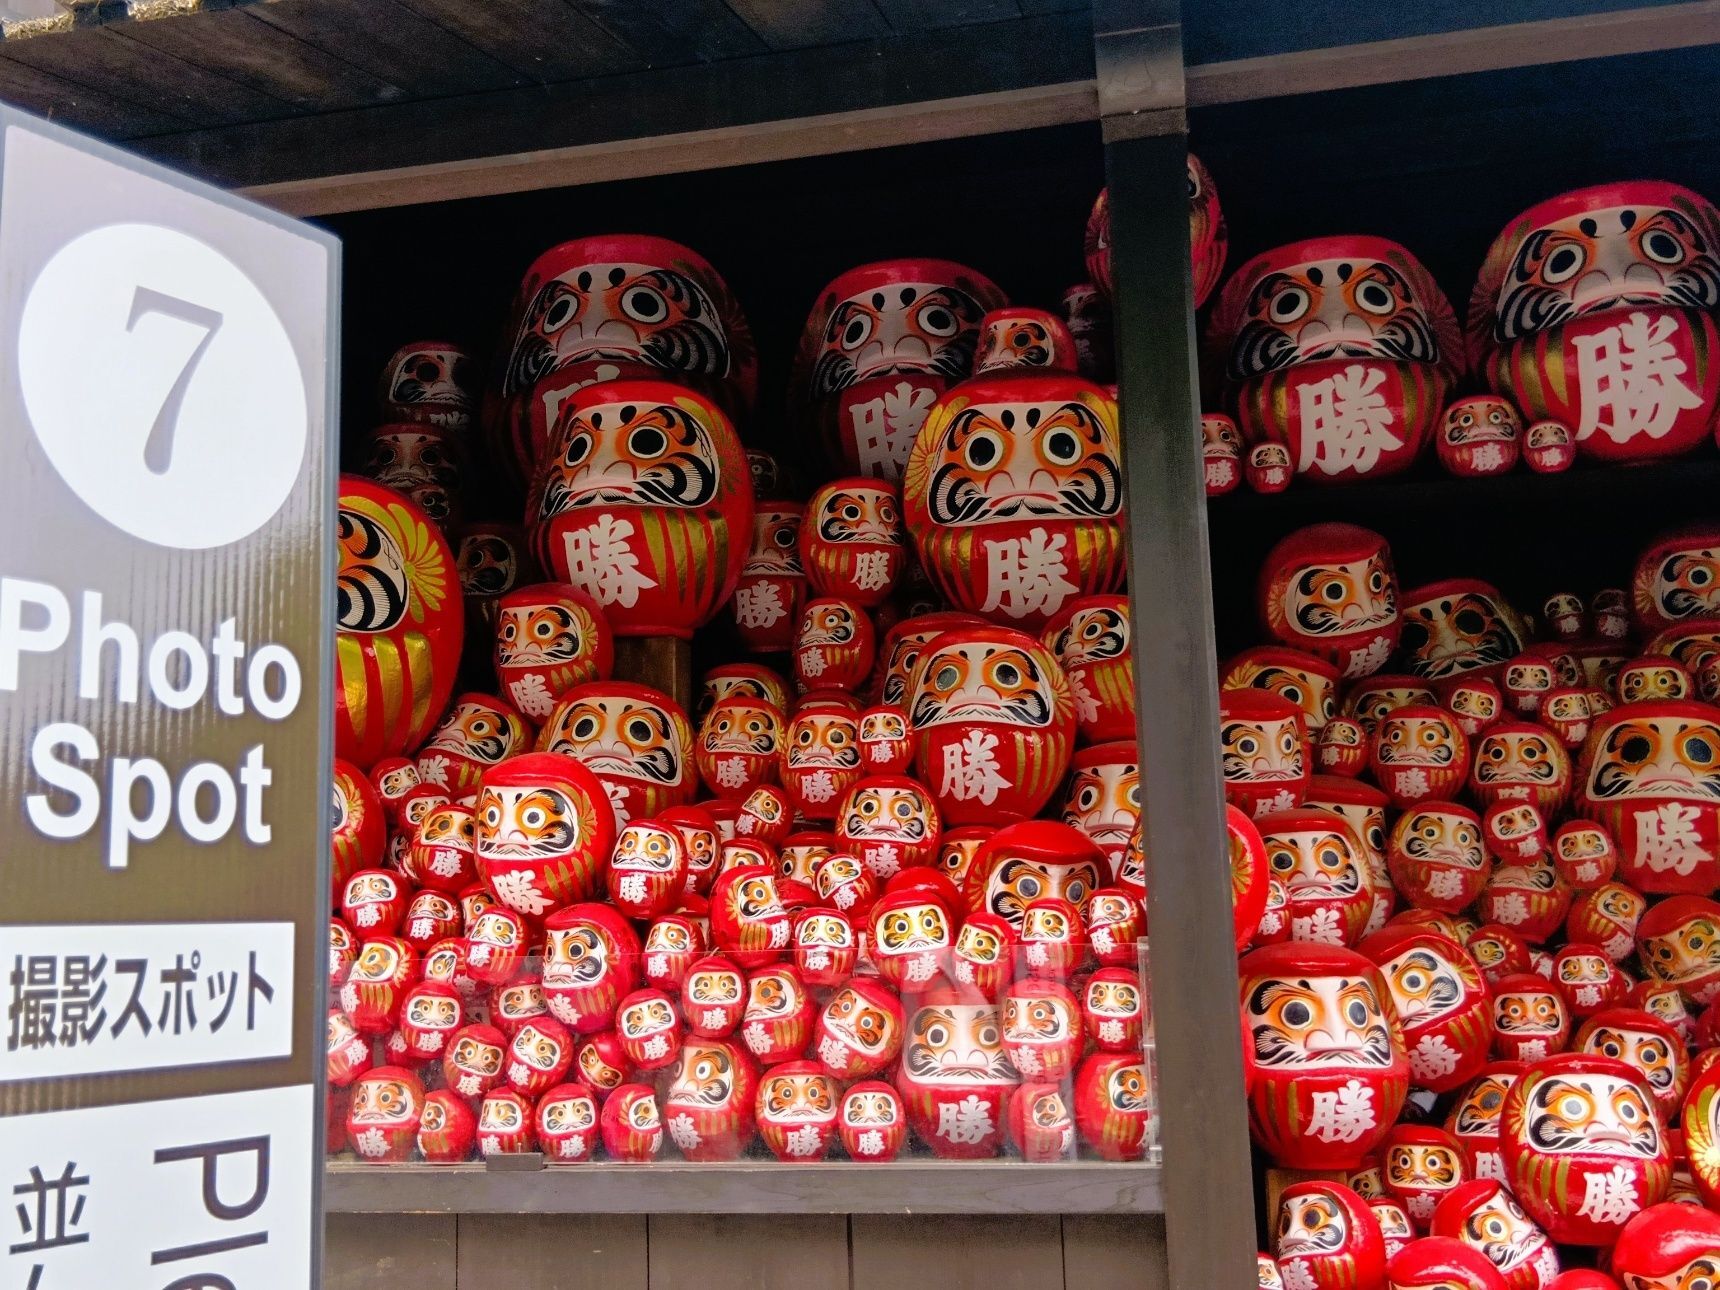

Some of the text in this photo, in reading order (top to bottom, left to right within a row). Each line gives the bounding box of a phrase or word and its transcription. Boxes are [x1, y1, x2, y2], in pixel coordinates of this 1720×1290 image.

[125, 285, 223, 476] 7
[1572, 312, 1705, 444] 勝
[1295, 365, 1404, 474] 勝
[1471, 444, 1506, 472] 勝
[1541, 448, 1564, 467] 勝
[1205, 461, 1233, 487] 勝
[1266, 468, 1284, 485] 勝
[562, 514, 658, 608] 勝
[850, 550, 891, 592] 勝
[981, 527, 1080, 618] 勝
[736, 580, 787, 628] 勝
[0, 576, 302, 720] Photo
[801, 647, 828, 678] 勝
[1342, 635, 1391, 679] 勝
[510, 674, 558, 717] 勝
[870, 740, 894, 763] 勝
[1321, 746, 1340, 766] 勝
[418, 755, 450, 792] 勝
[716, 756, 750, 788] 勝
[940, 730, 1013, 806] 勝
[27, 722, 272, 869] Spot
[801, 770, 837, 803] 勝
[1395, 768, 1430, 799] 勝
[735, 814, 757, 835] 勝
[1633, 802, 1714, 876] 勝
[865, 843, 901, 878] 勝
[1518, 836, 1541, 857] 勝
[429, 849, 462, 878] 勝
[1575, 861, 1600, 882] 勝
[491, 870, 555, 916] 勝
[620, 873, 648, 903] 勝
[833, 884, 858, 910] 勝
[1424, 868, 1463, 900] 勝
[355, 903, 381, 927] 勝
[1258, 911, 1282, 935] 勝
[1493, 892, 1530, 925] 勝
[410, 918, 434, 940] 勝
[768, 918, 791, 949] 勝
[1090, 927, 1118, 954] 勝
[467, 943, 491, 967] 勝
[1026, 942, 1050, 966] 勝
[1602, 931, 1635, 961] 勝
[647, 953, 670, 977] 勝
[905, 952, 939, 982] 勝
[955, 961, 975, 984] 勝
[7, 950, 274, 1052] 撮影スポット
[547, 992, 582, 1025] 勝
[1576, 985, 1602, 1007] 勝
[701, 1007, 728, 1030] 勝
[1099, 1019, 1125, 1043] 勝
[345, 1039, 369, 1066] 勝
[417, 1031, 443, 1053] 勝
[643, 1035, 670, 1059] 勝
[743, 1021, 774, 1055] 勝
[818, 1034, 849, 1069] 勝
[1009, 1045, 1043, 1076] 勝
[1408, 1034, 1463, 1080] 勝
[456, 1075, 482, 1095] 勝
[508, 1062, 531, 1085] 勝
[936, 1095, 995, 1144] 勝
[1304, 1079, 1376, 1143] 勝
[356, 1127, 391, 1157] 勝
[668, 1113, 702, 1149] 勝
[786, 1125, 822, 1156] 勝
[858, 1130, 885, 1155] 勝
[560, 1135, 586, 1158] 勝
[1406, 1192, 1437, 1219] 勝
[1576, 1164, 1641, 1225] 勝
